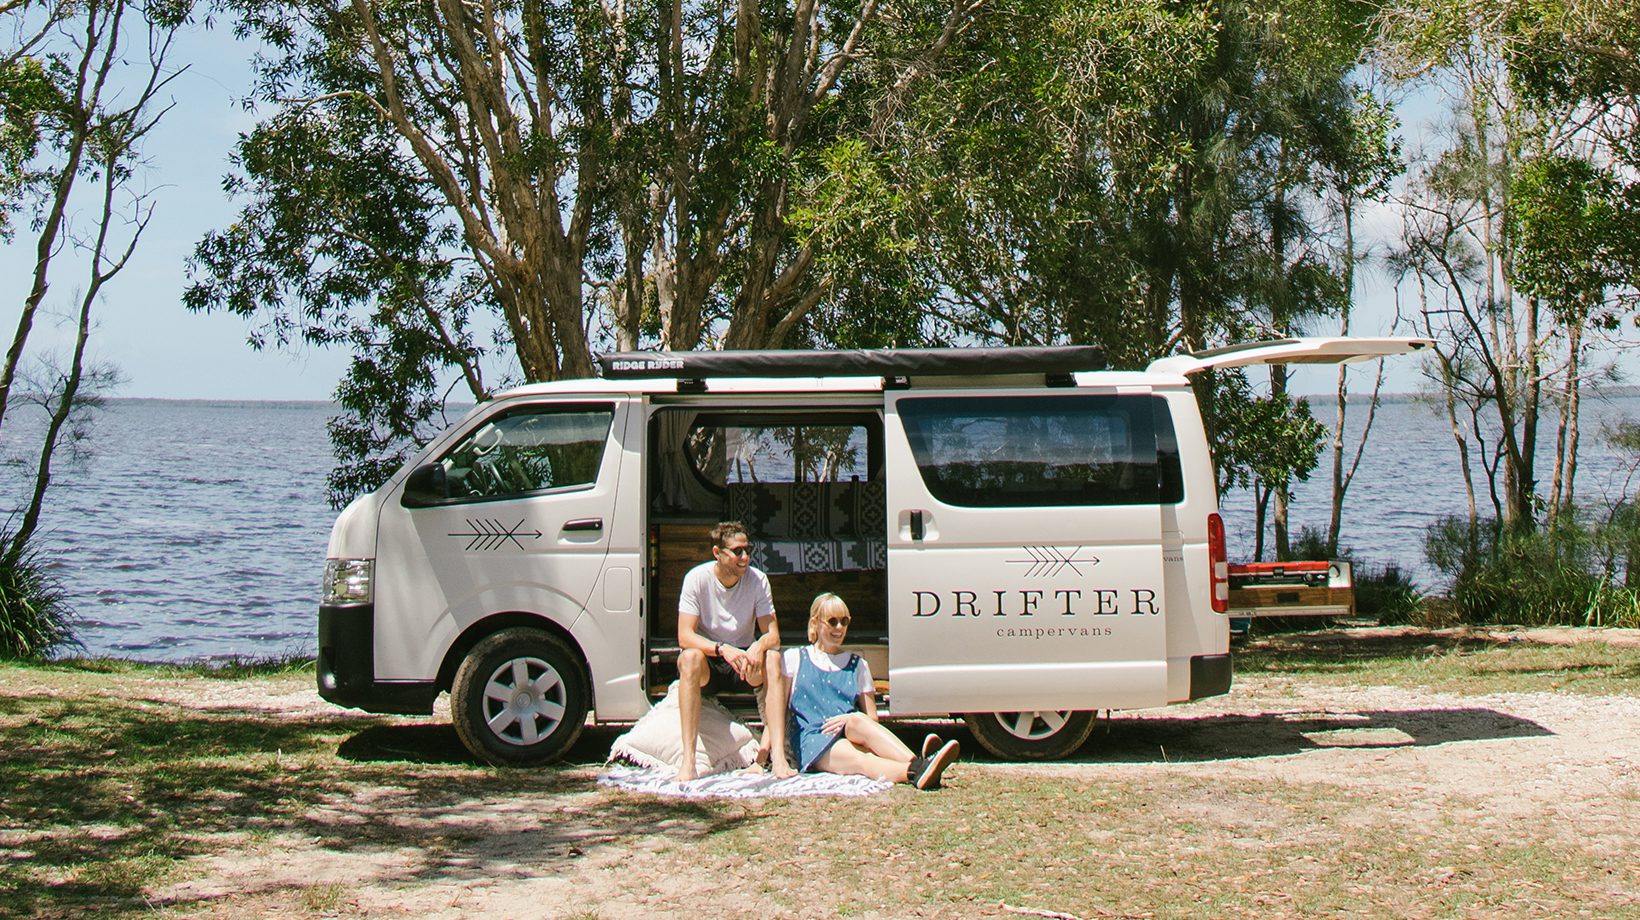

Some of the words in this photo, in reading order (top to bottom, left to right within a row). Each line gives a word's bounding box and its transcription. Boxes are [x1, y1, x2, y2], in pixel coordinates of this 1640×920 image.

[612, 361, 646, 370] RIDGE
[647, 360, 684, 369] RYDER
[912, 589, 1160, 617] DRIFTER
[996, 627, 1112, 640] campervans
